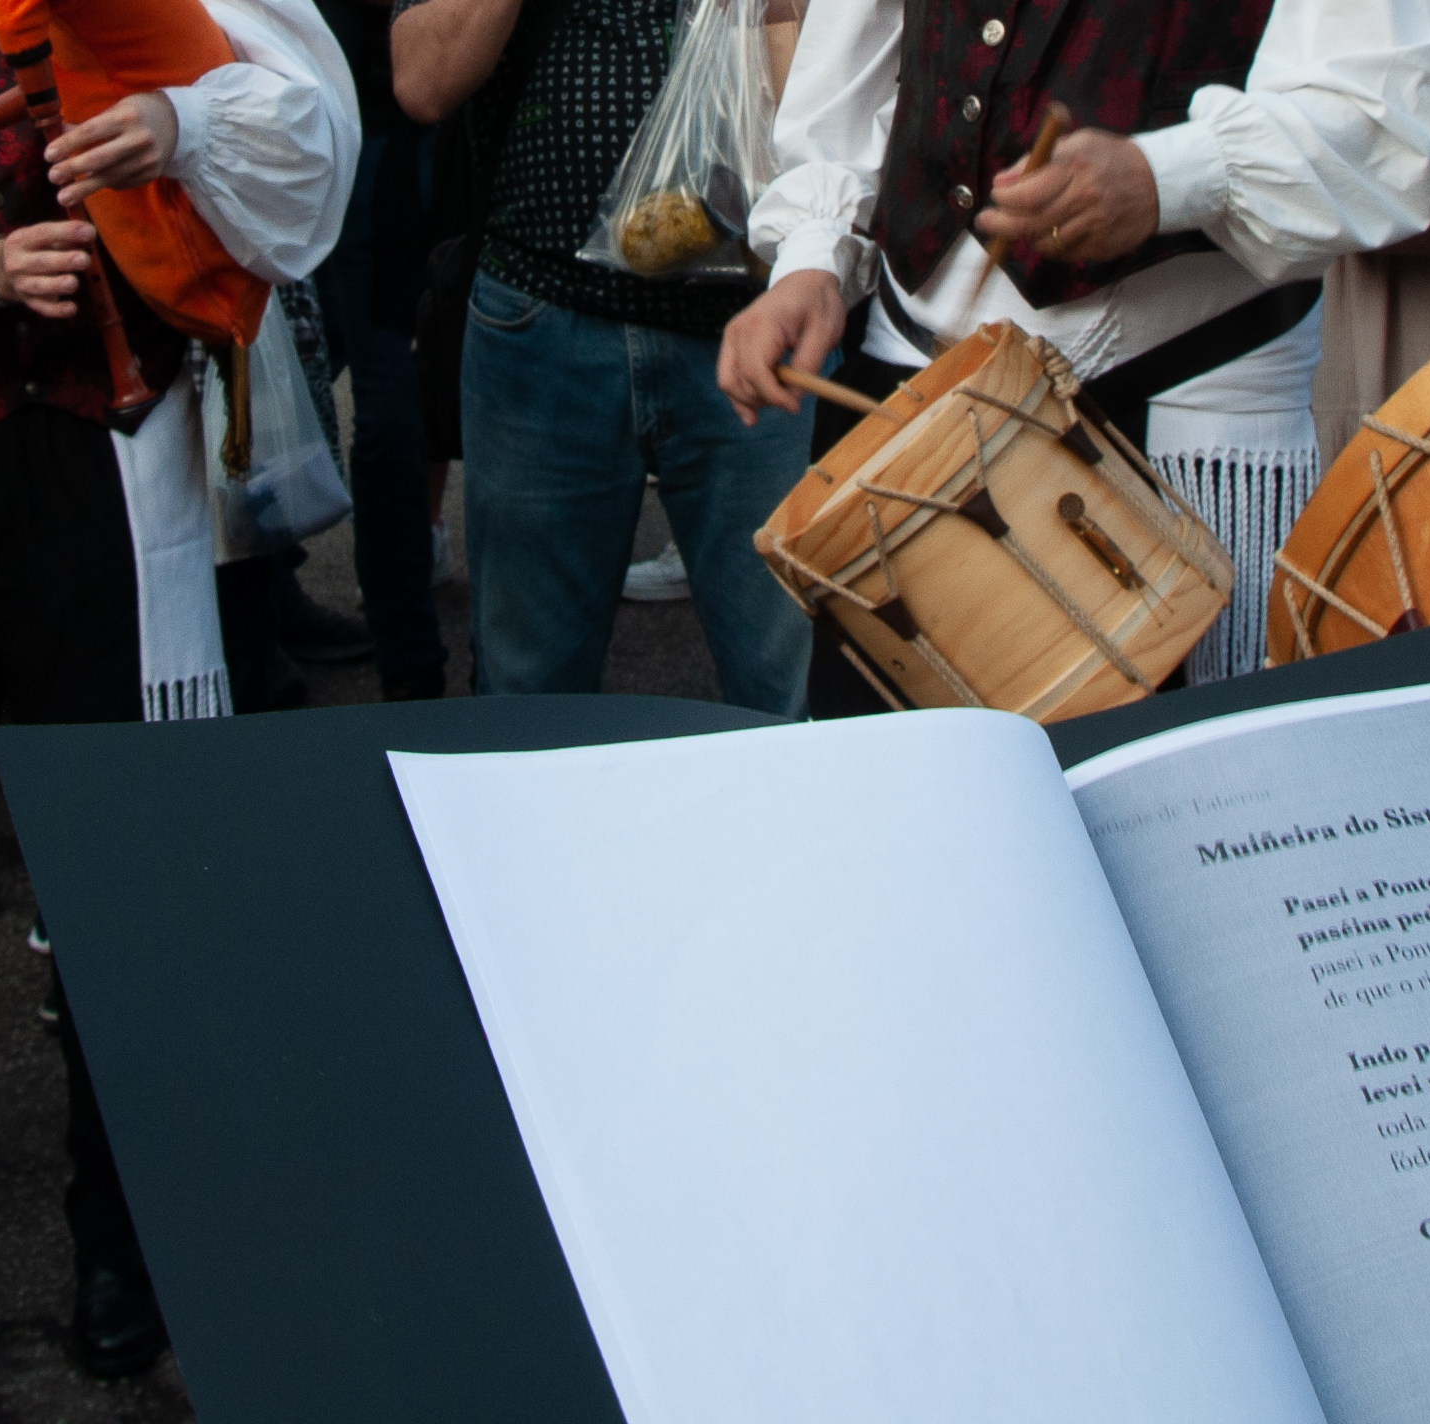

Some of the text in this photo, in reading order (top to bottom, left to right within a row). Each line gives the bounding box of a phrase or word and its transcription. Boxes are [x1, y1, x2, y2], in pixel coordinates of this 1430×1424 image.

[1195, 825, 1339, 865] Muiñeira
[1345, 815, 1379, 837] do
[1282, 885, 1351, 916] Pasei
[1355, 887, 1371, 903] a
[1310, 949, 1364, 986] pasei
[1370, 951, 1382, 968] a
[1323, 989, 1350, 1011] de
[1355, 981, 1392, 1007] que
[1399, 977, 1414, 995] o
[1347, 1043, 1409, 1072] Indo
[1359, 1072, 1423, 1105] levei
[1377, 1111, 1427, 1140] toda
